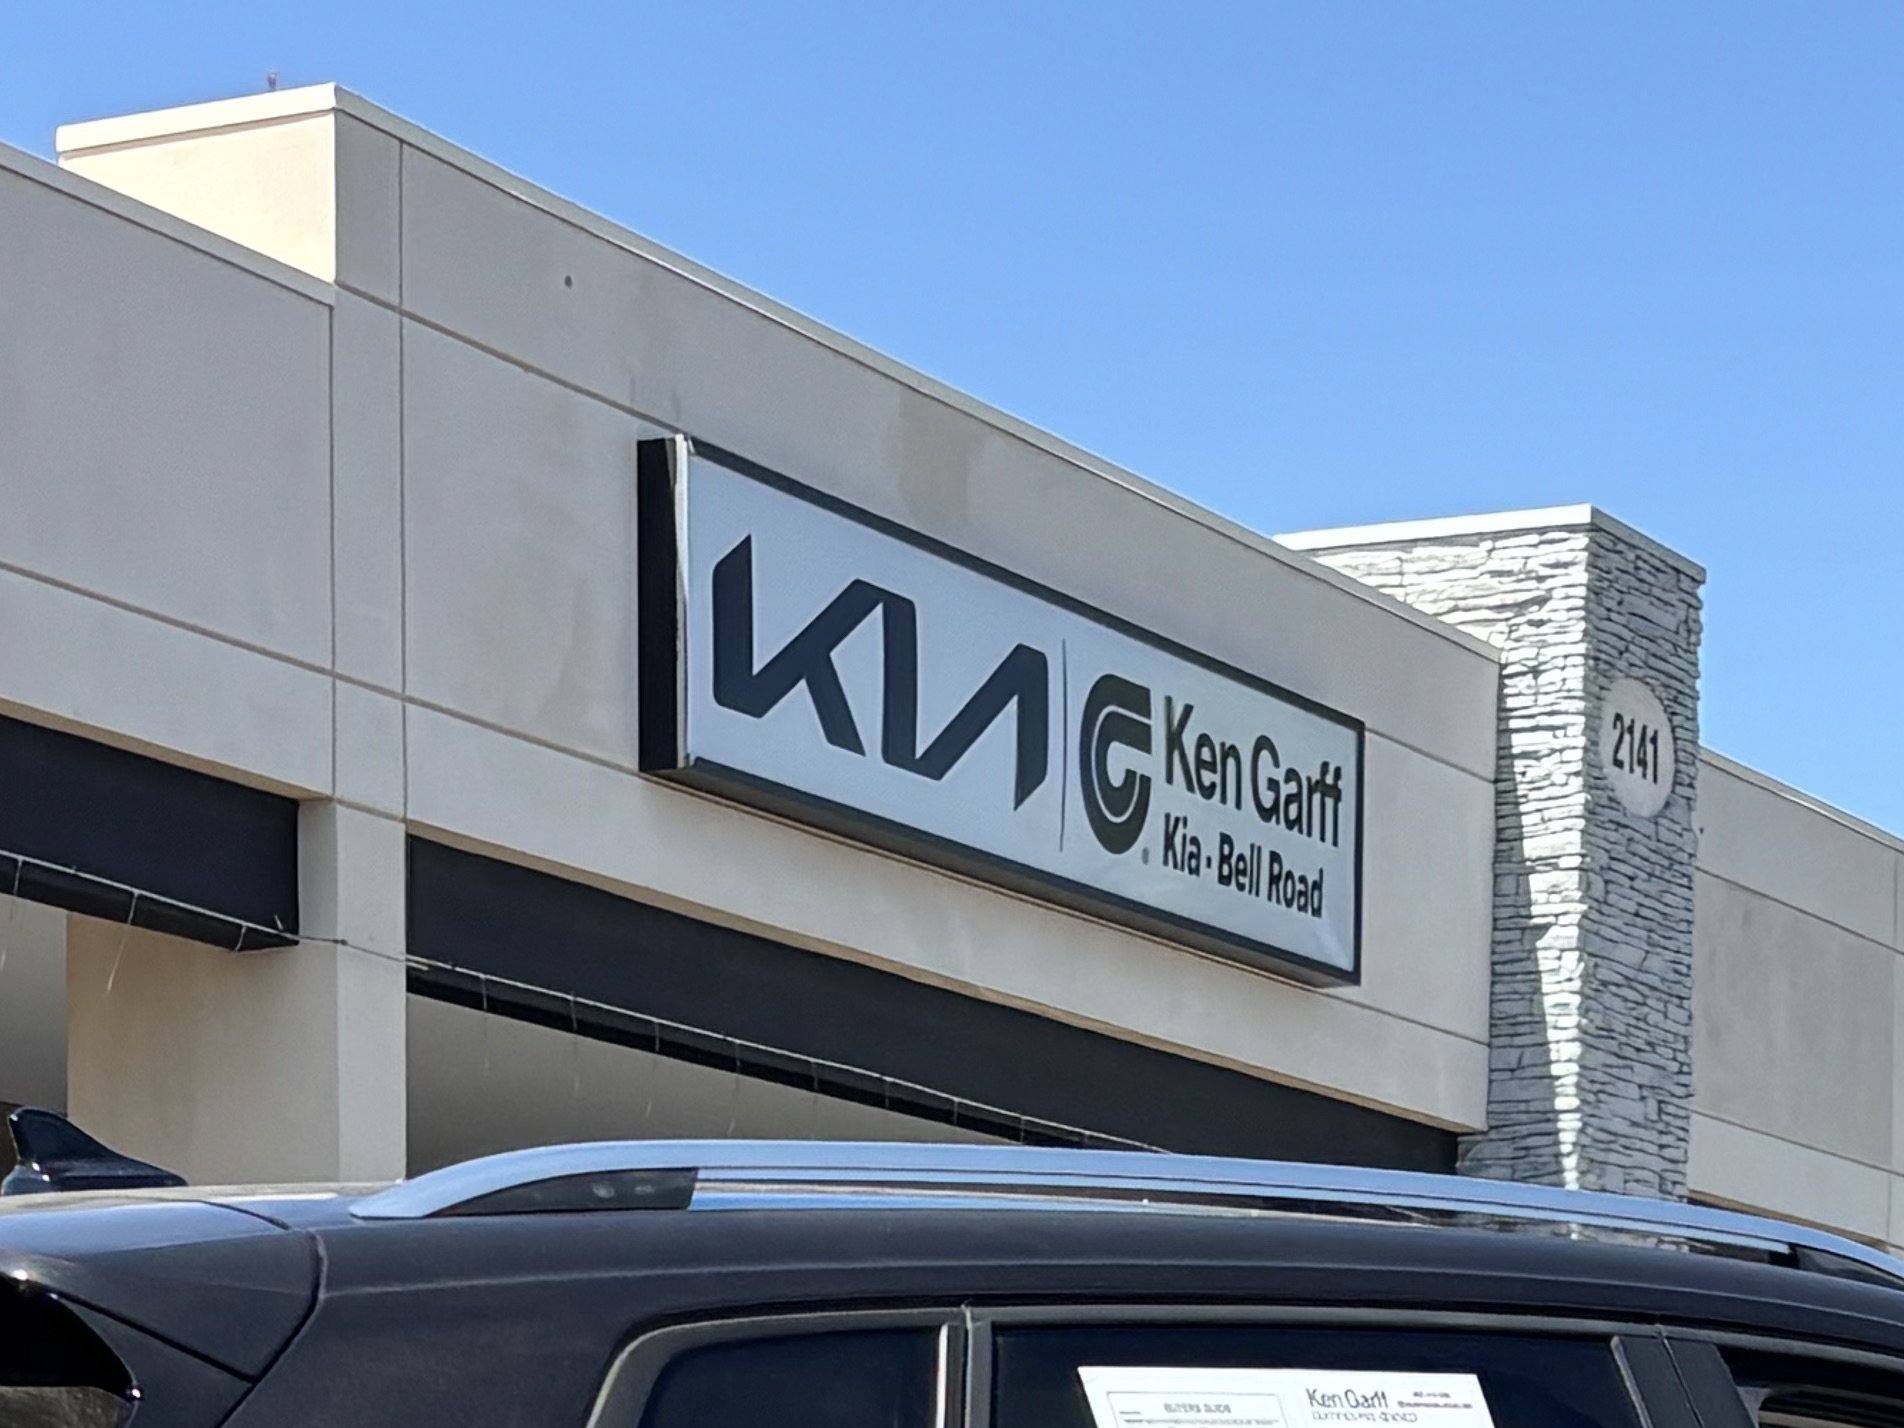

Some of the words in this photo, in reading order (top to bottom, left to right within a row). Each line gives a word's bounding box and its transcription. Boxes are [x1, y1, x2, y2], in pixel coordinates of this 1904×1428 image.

[1163, 695, 1242, 811] Ken
[1250, 734, 1343, 848] Garff
[1612, 711, 1659, 785] 2141
[1162, 812, 1201, 878] Kia
[1217, 831, 1263, 898] Bell
[1266, 849, 1325, 919] Road
